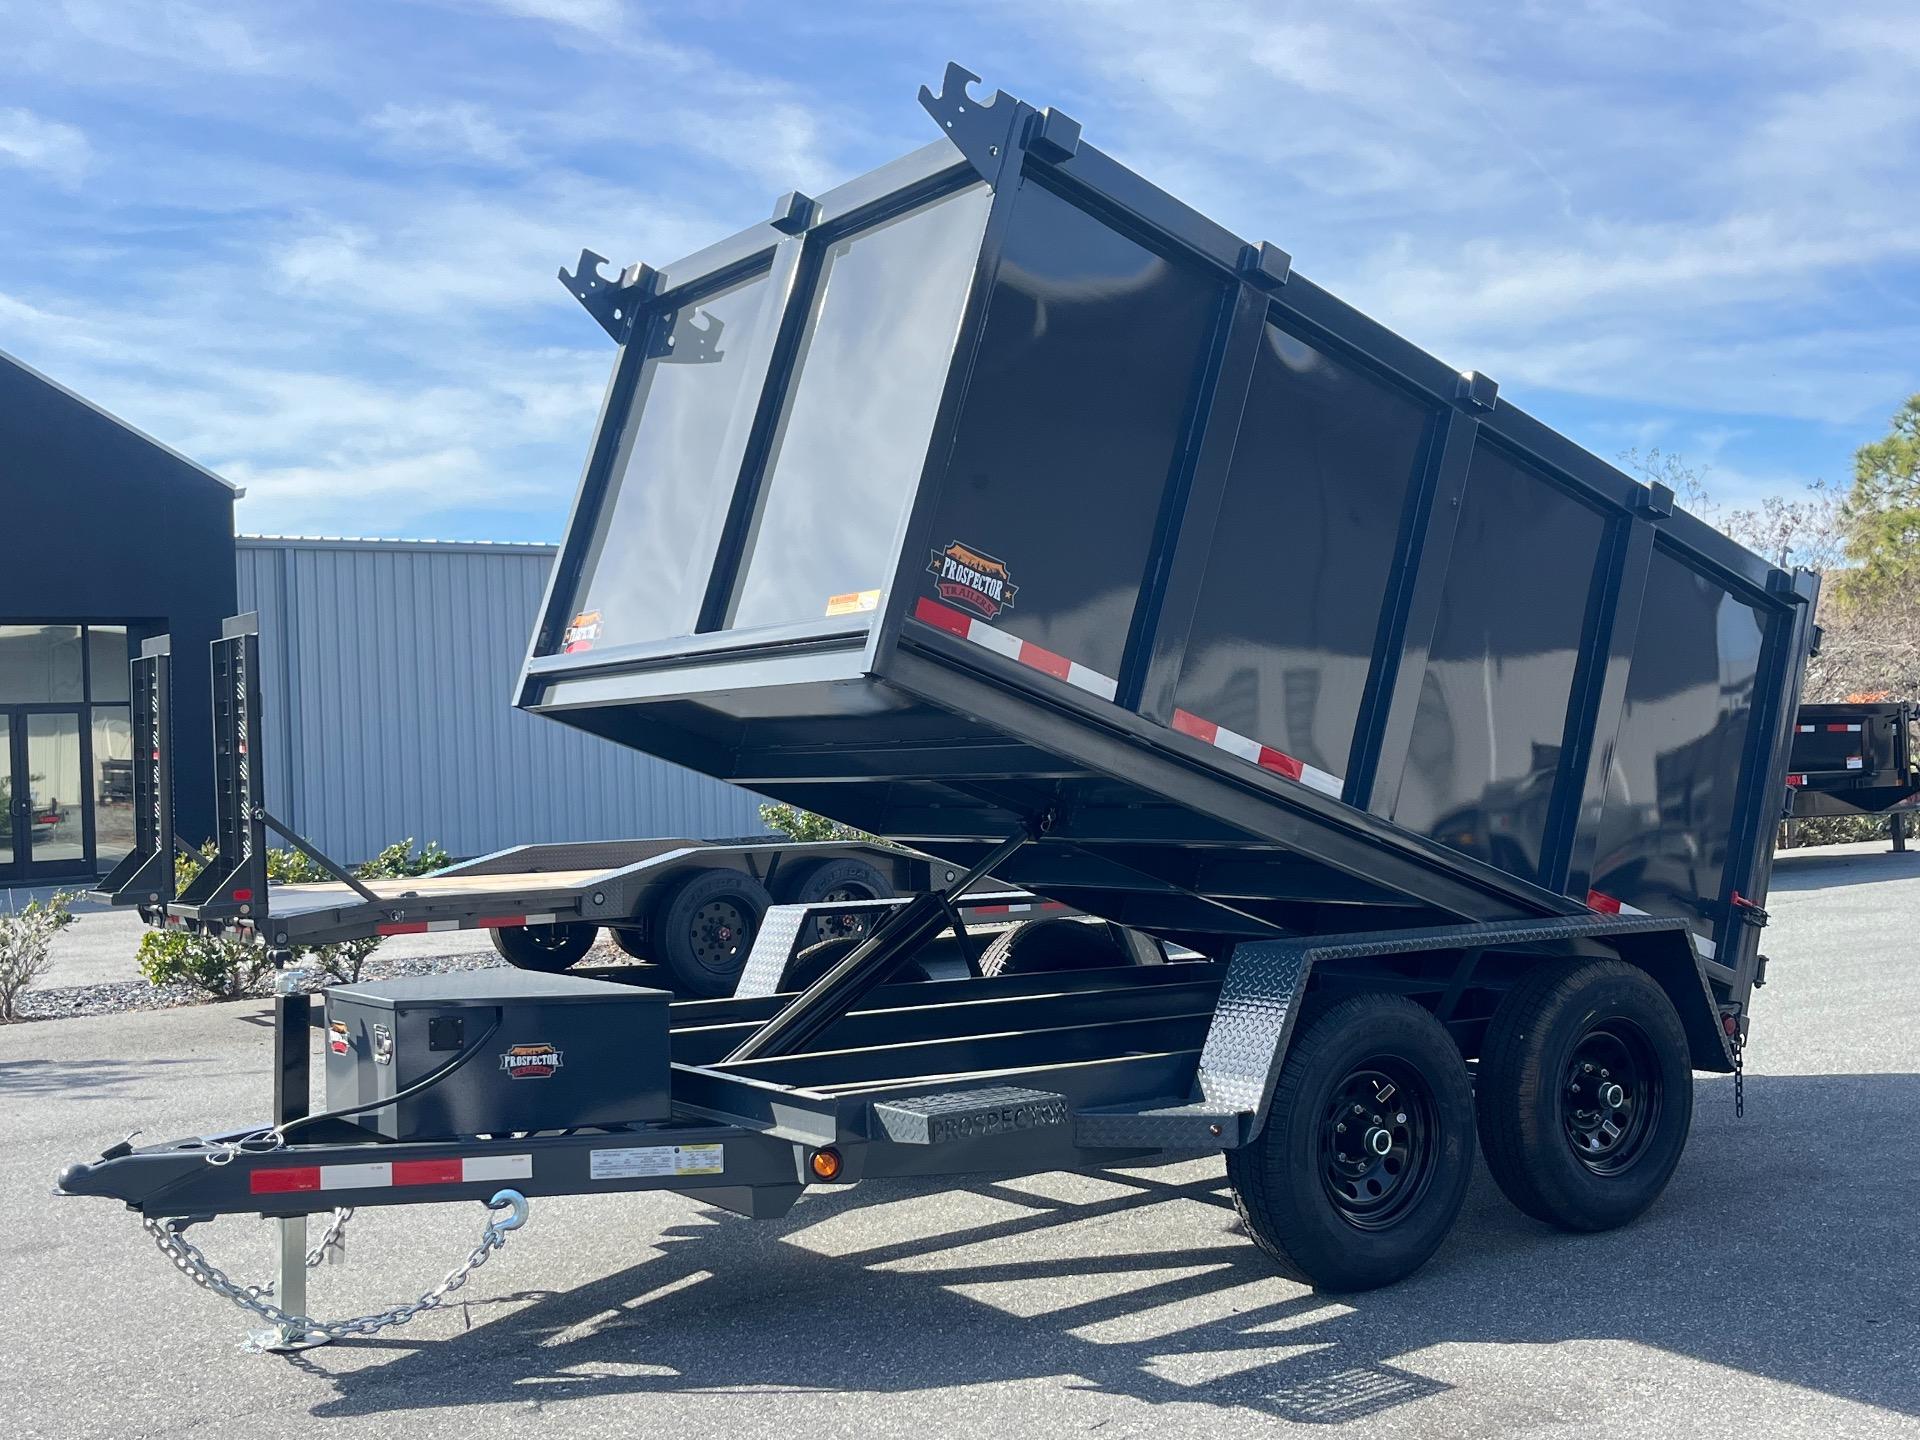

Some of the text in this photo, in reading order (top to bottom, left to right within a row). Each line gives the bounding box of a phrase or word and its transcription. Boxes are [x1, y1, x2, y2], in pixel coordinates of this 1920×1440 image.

[941, 557, 1003, 602] PROSPECTOR
[944, 585, 994, 613] TRAILERS
[504, 1053, 559, 1068] PROSPECTOR
